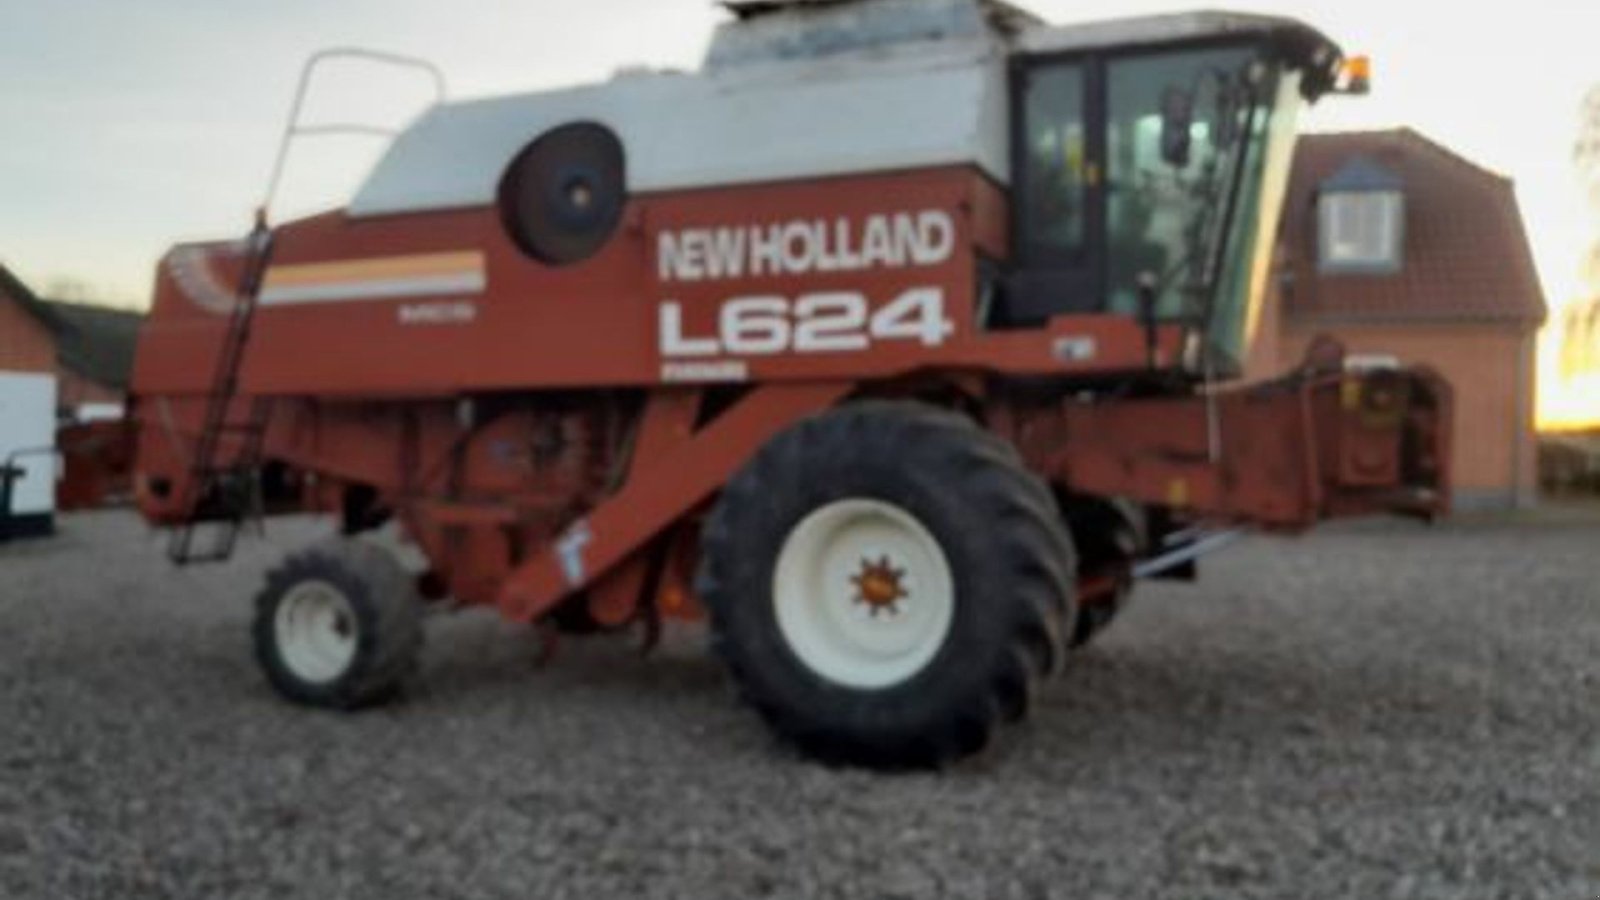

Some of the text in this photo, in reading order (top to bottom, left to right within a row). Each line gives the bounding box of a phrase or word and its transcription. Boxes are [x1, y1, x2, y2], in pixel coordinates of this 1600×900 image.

[658, 210, 954, 280] NEW HOLLAND
[659, 287, 954, 355] L624
